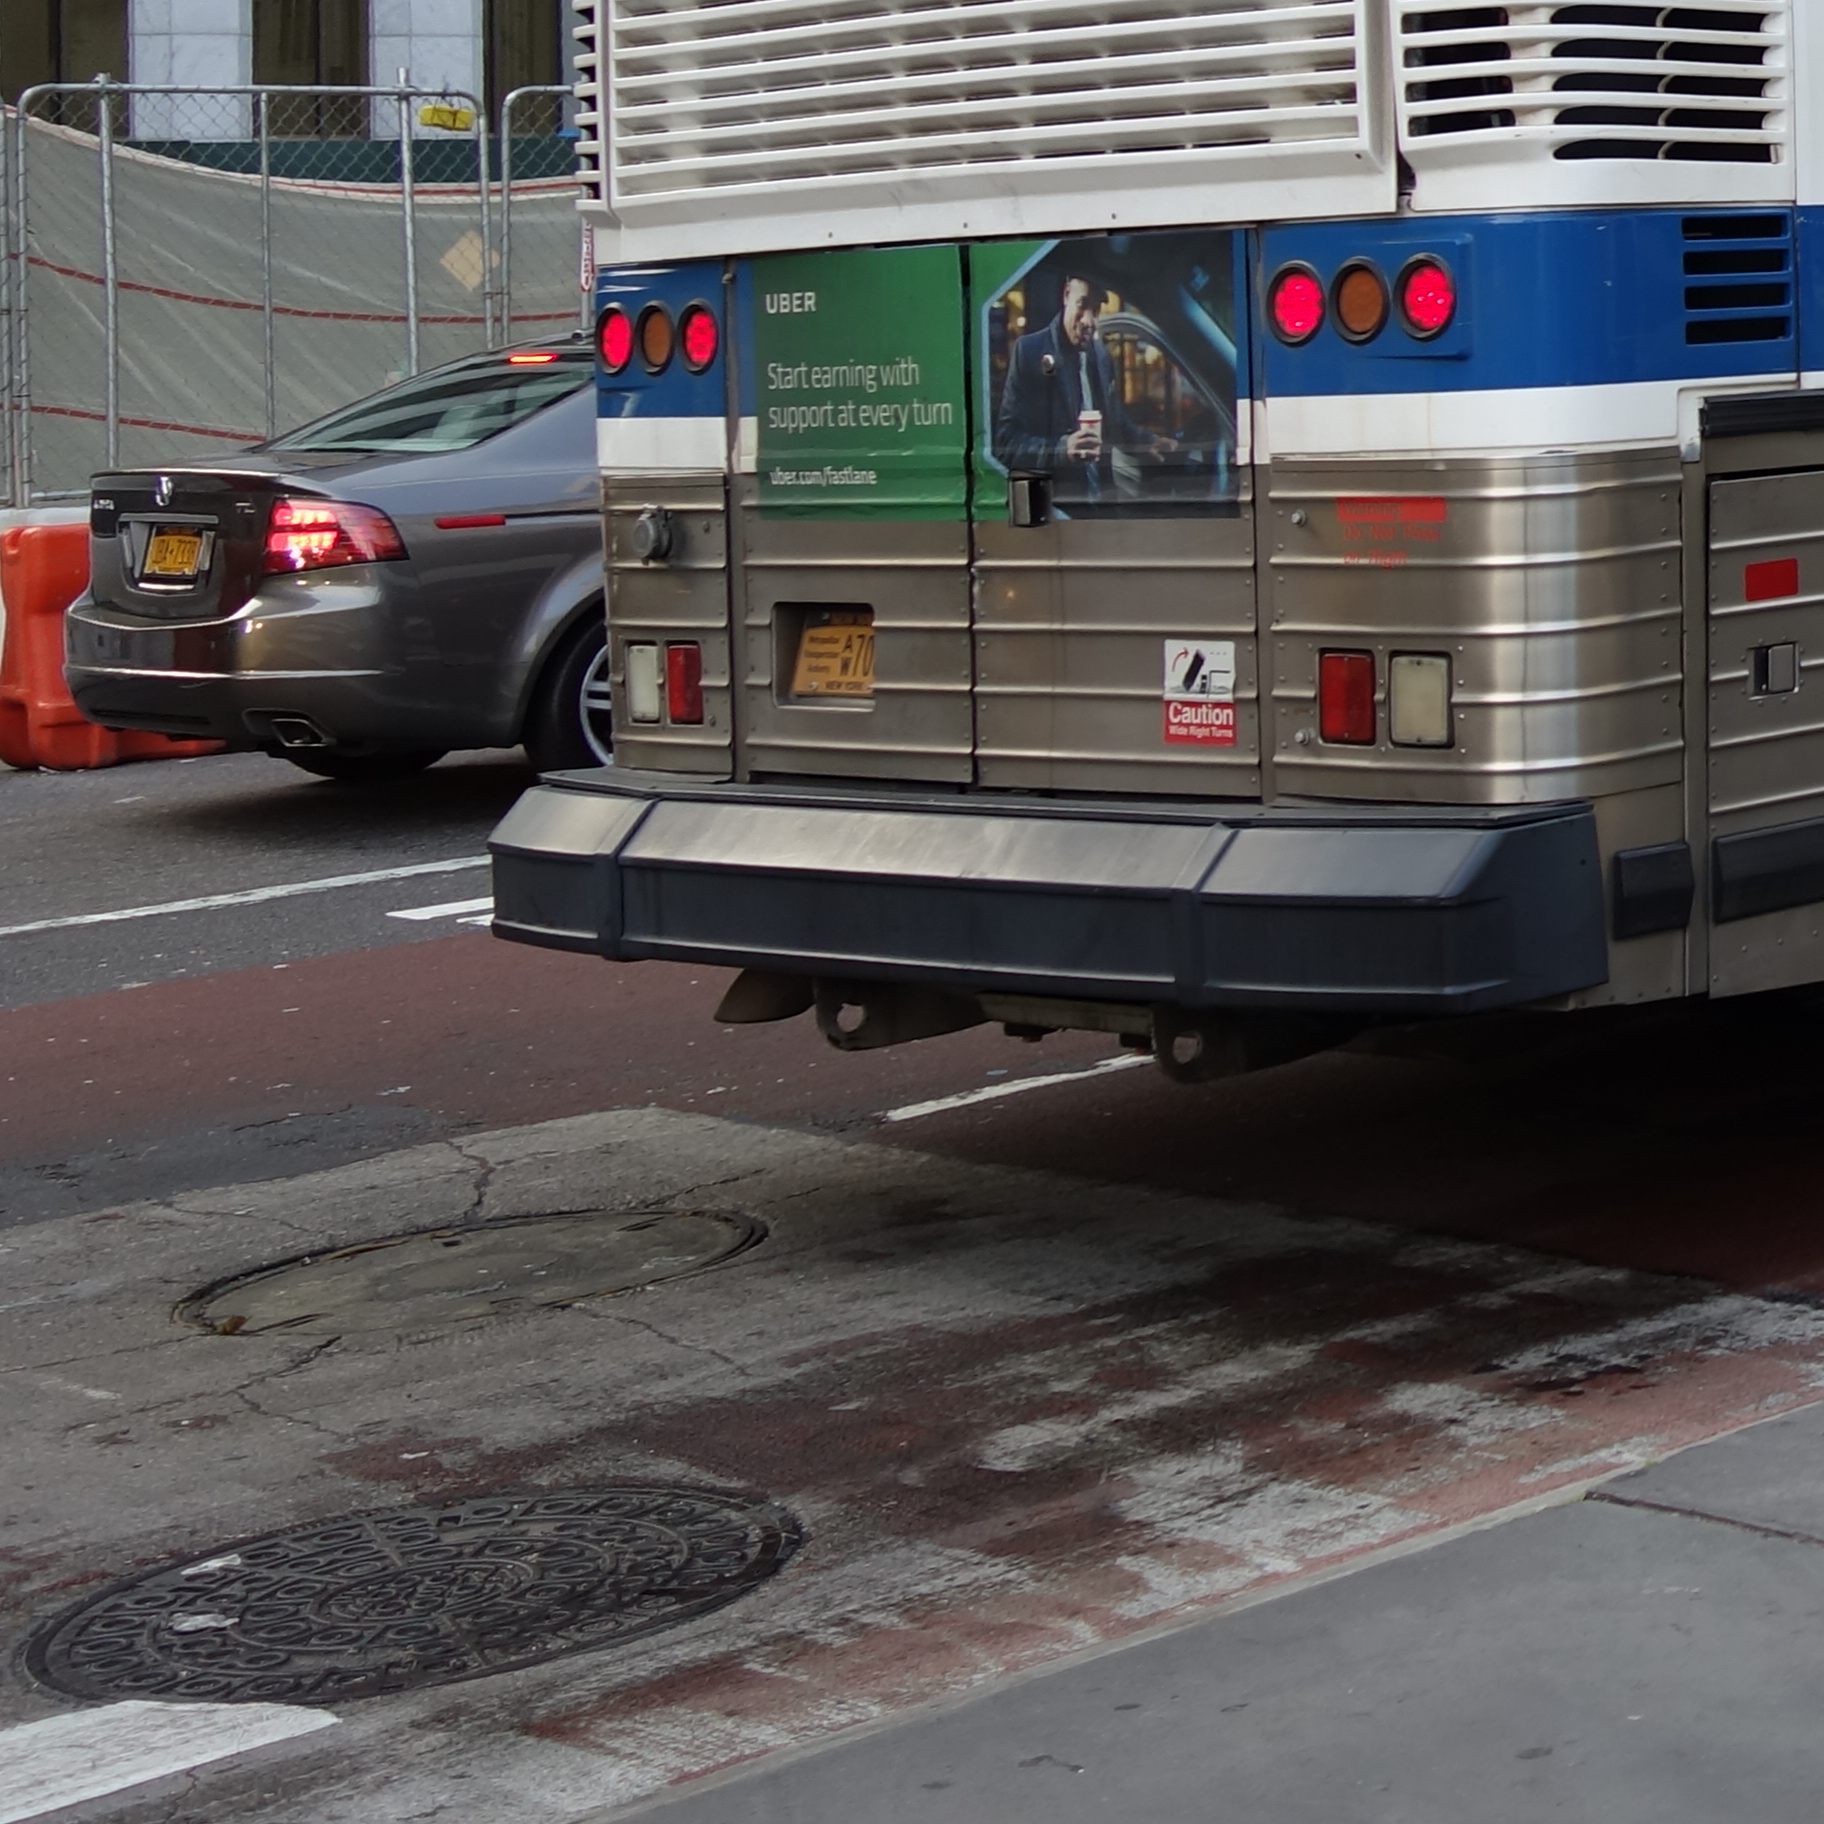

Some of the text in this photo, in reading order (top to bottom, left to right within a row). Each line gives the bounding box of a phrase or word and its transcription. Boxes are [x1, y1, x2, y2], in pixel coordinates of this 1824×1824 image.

[765, 291, 817, 314] UBER
[767, 356, 919, 393] Start earning with
[768, 398, 953, 434] support at every turn
[769, 465, 878, 487] uber.com/fastlane
[1168, 701, 1233, 726] Caution
[1168, 725, 1233, 739] Wide Right Turns
